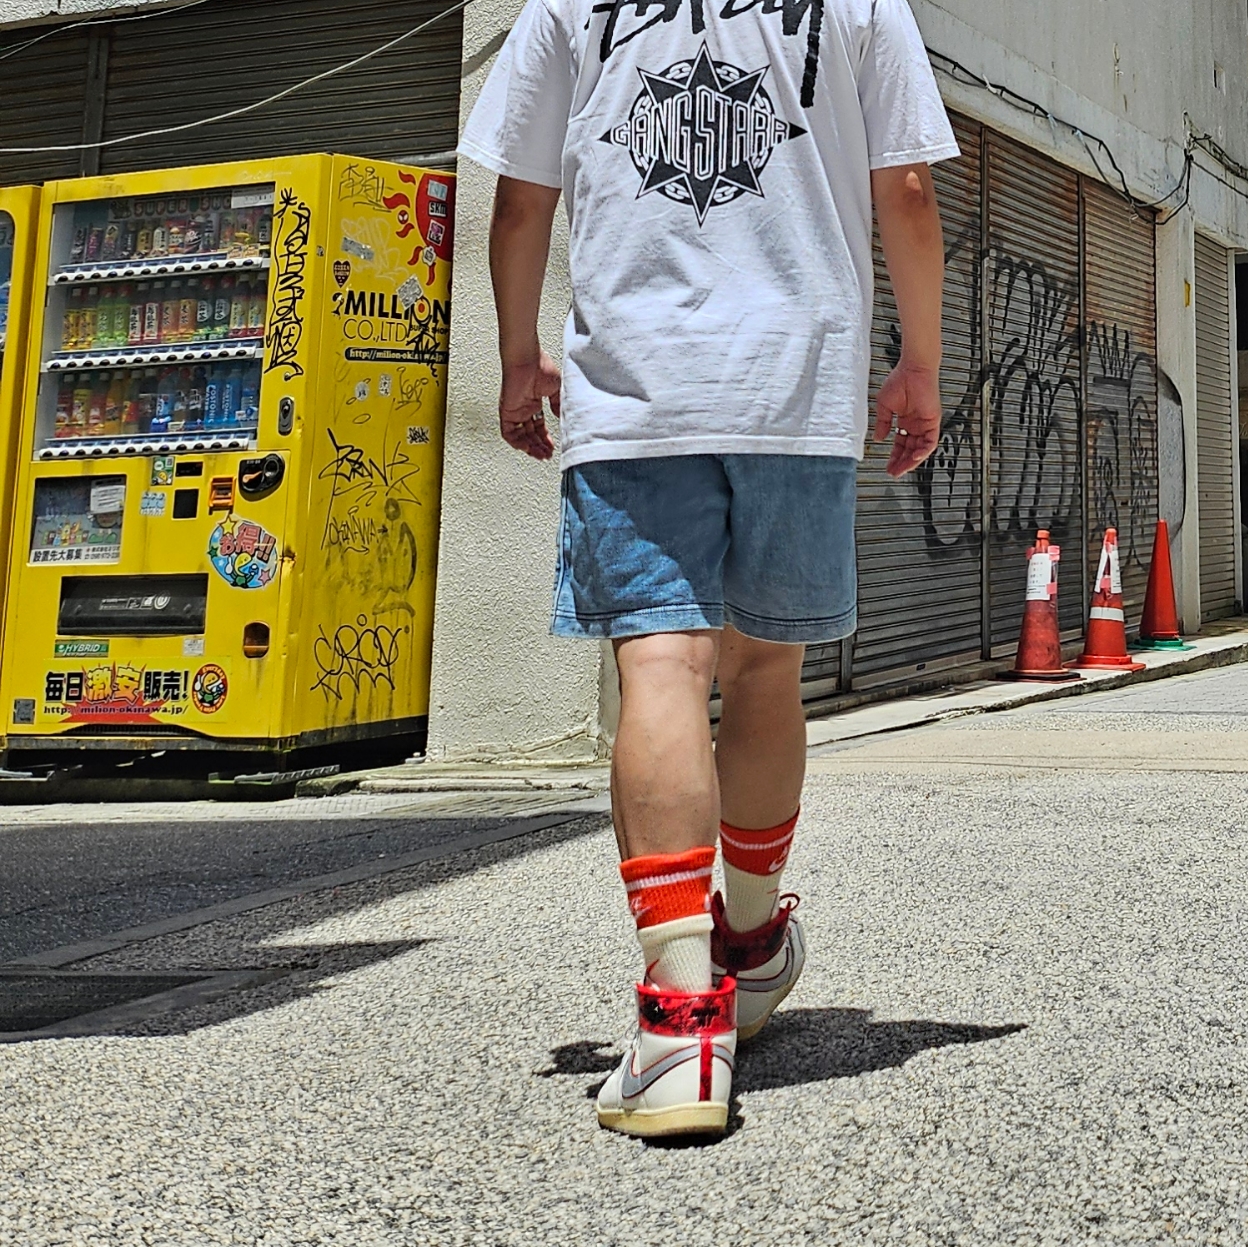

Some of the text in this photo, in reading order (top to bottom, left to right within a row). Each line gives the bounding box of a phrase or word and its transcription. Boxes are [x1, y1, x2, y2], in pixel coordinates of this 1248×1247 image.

[33, 548, 82, 562] 設置先大募集
[65, 643, 100, 653] HYBRID
[45, 668, 189, 704] 毎日激安販売!
